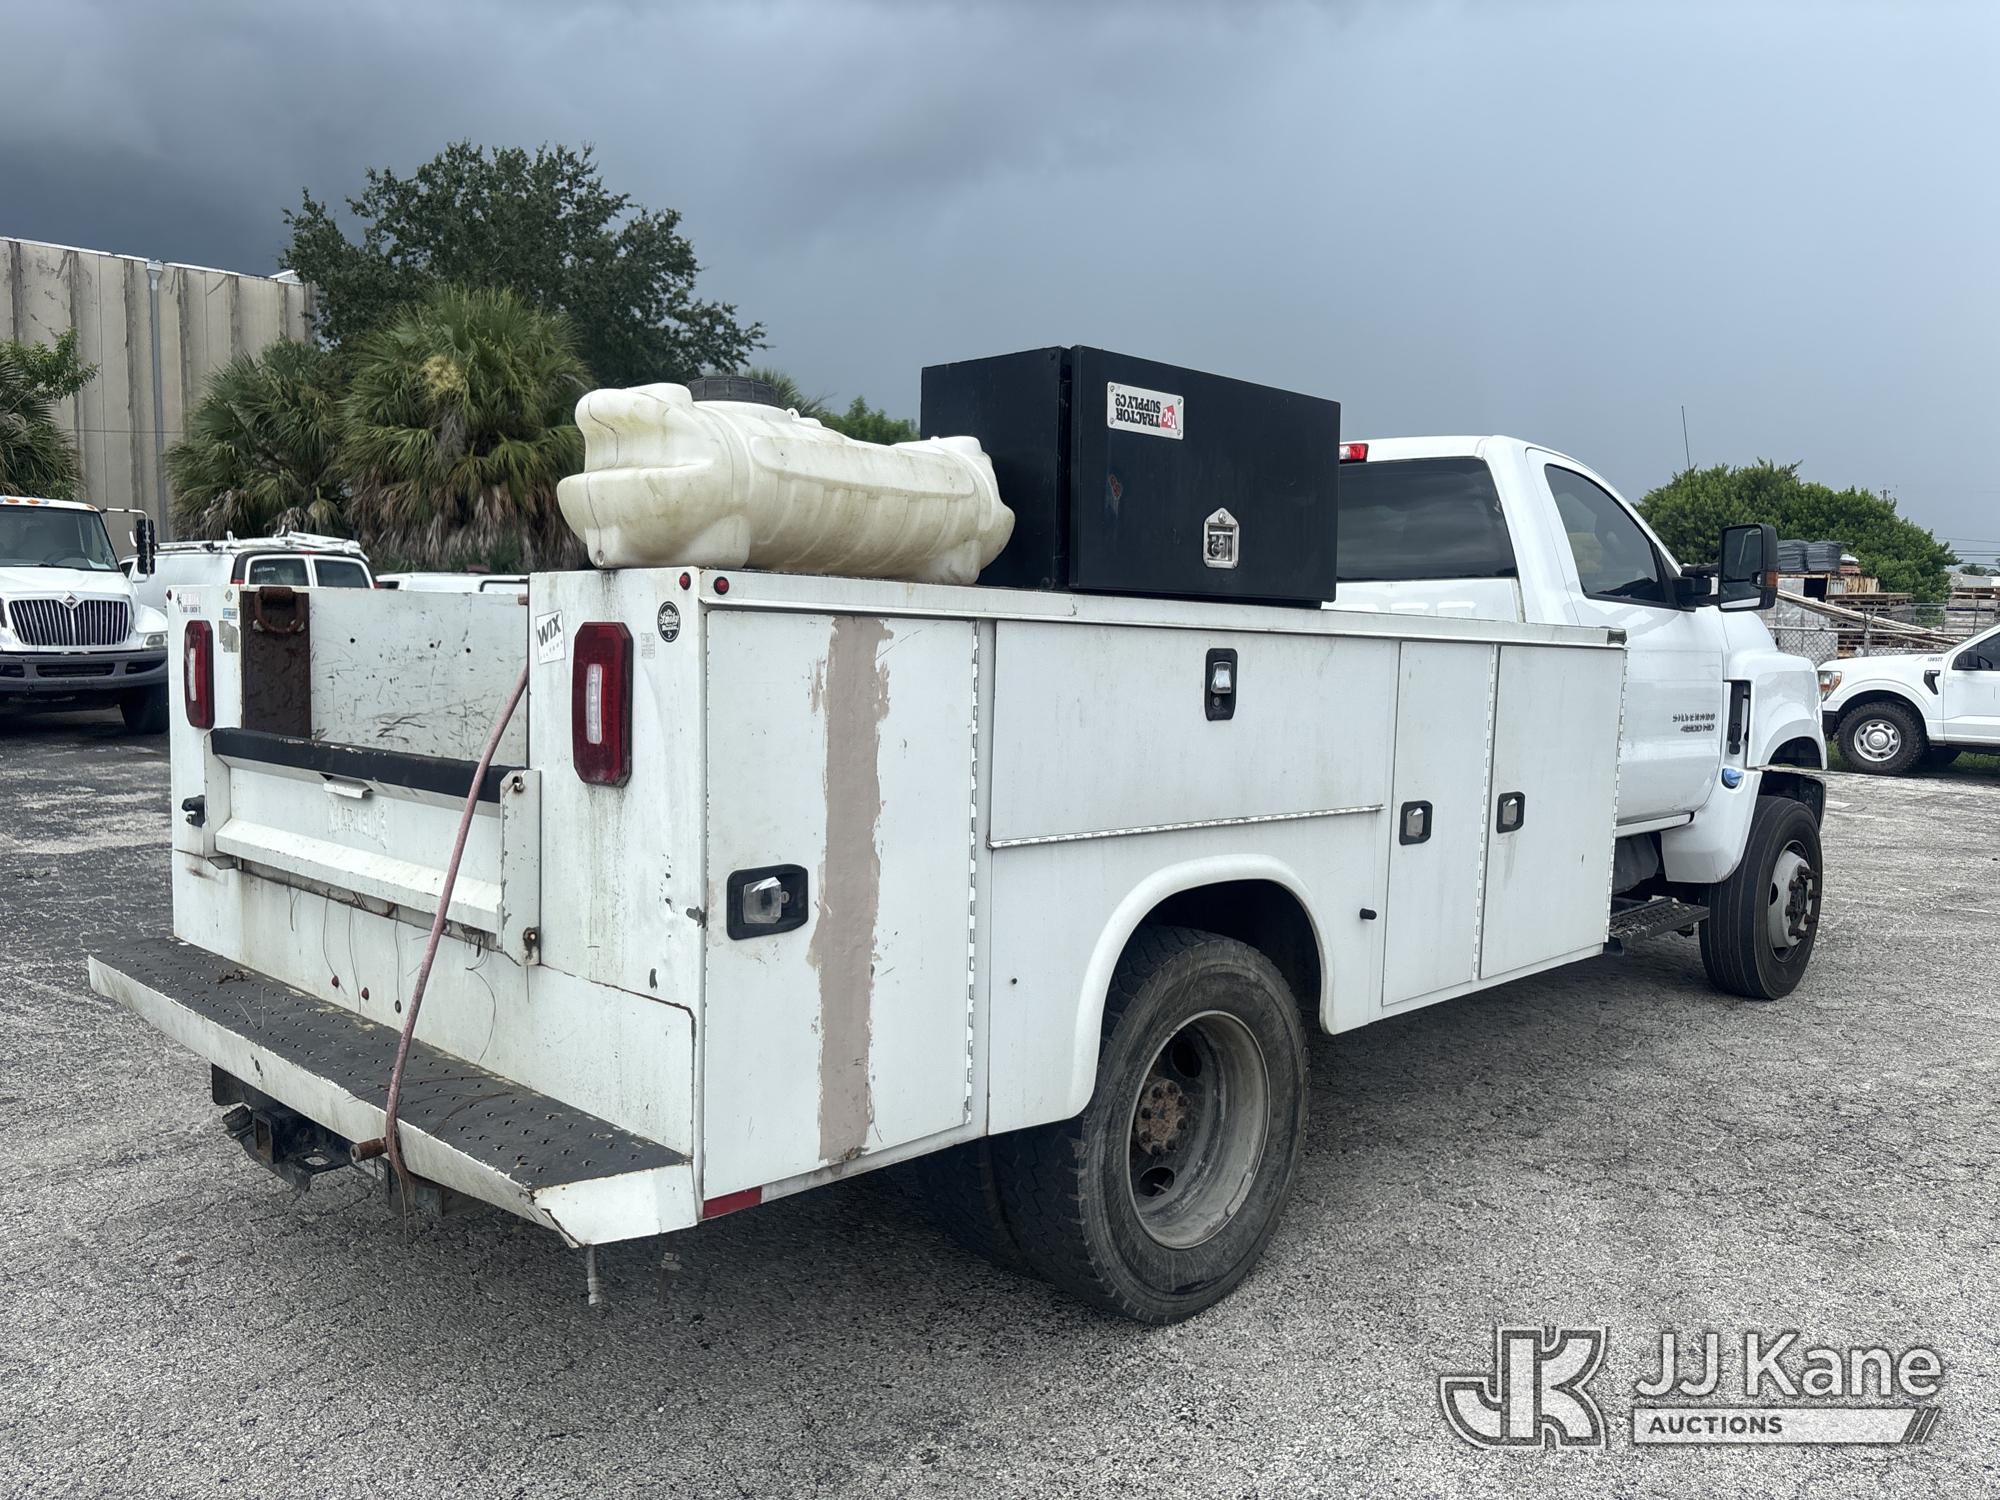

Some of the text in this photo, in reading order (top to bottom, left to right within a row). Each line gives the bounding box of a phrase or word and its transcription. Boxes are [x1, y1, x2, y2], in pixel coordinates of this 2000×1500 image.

[1126, 395, 1161, 414] SUPPLY
[1115, 407, 1161, 428] TRACTOR
[537, 613, 561, 647] WIX
[1672, 712, 1716, 722] SILVERADO
